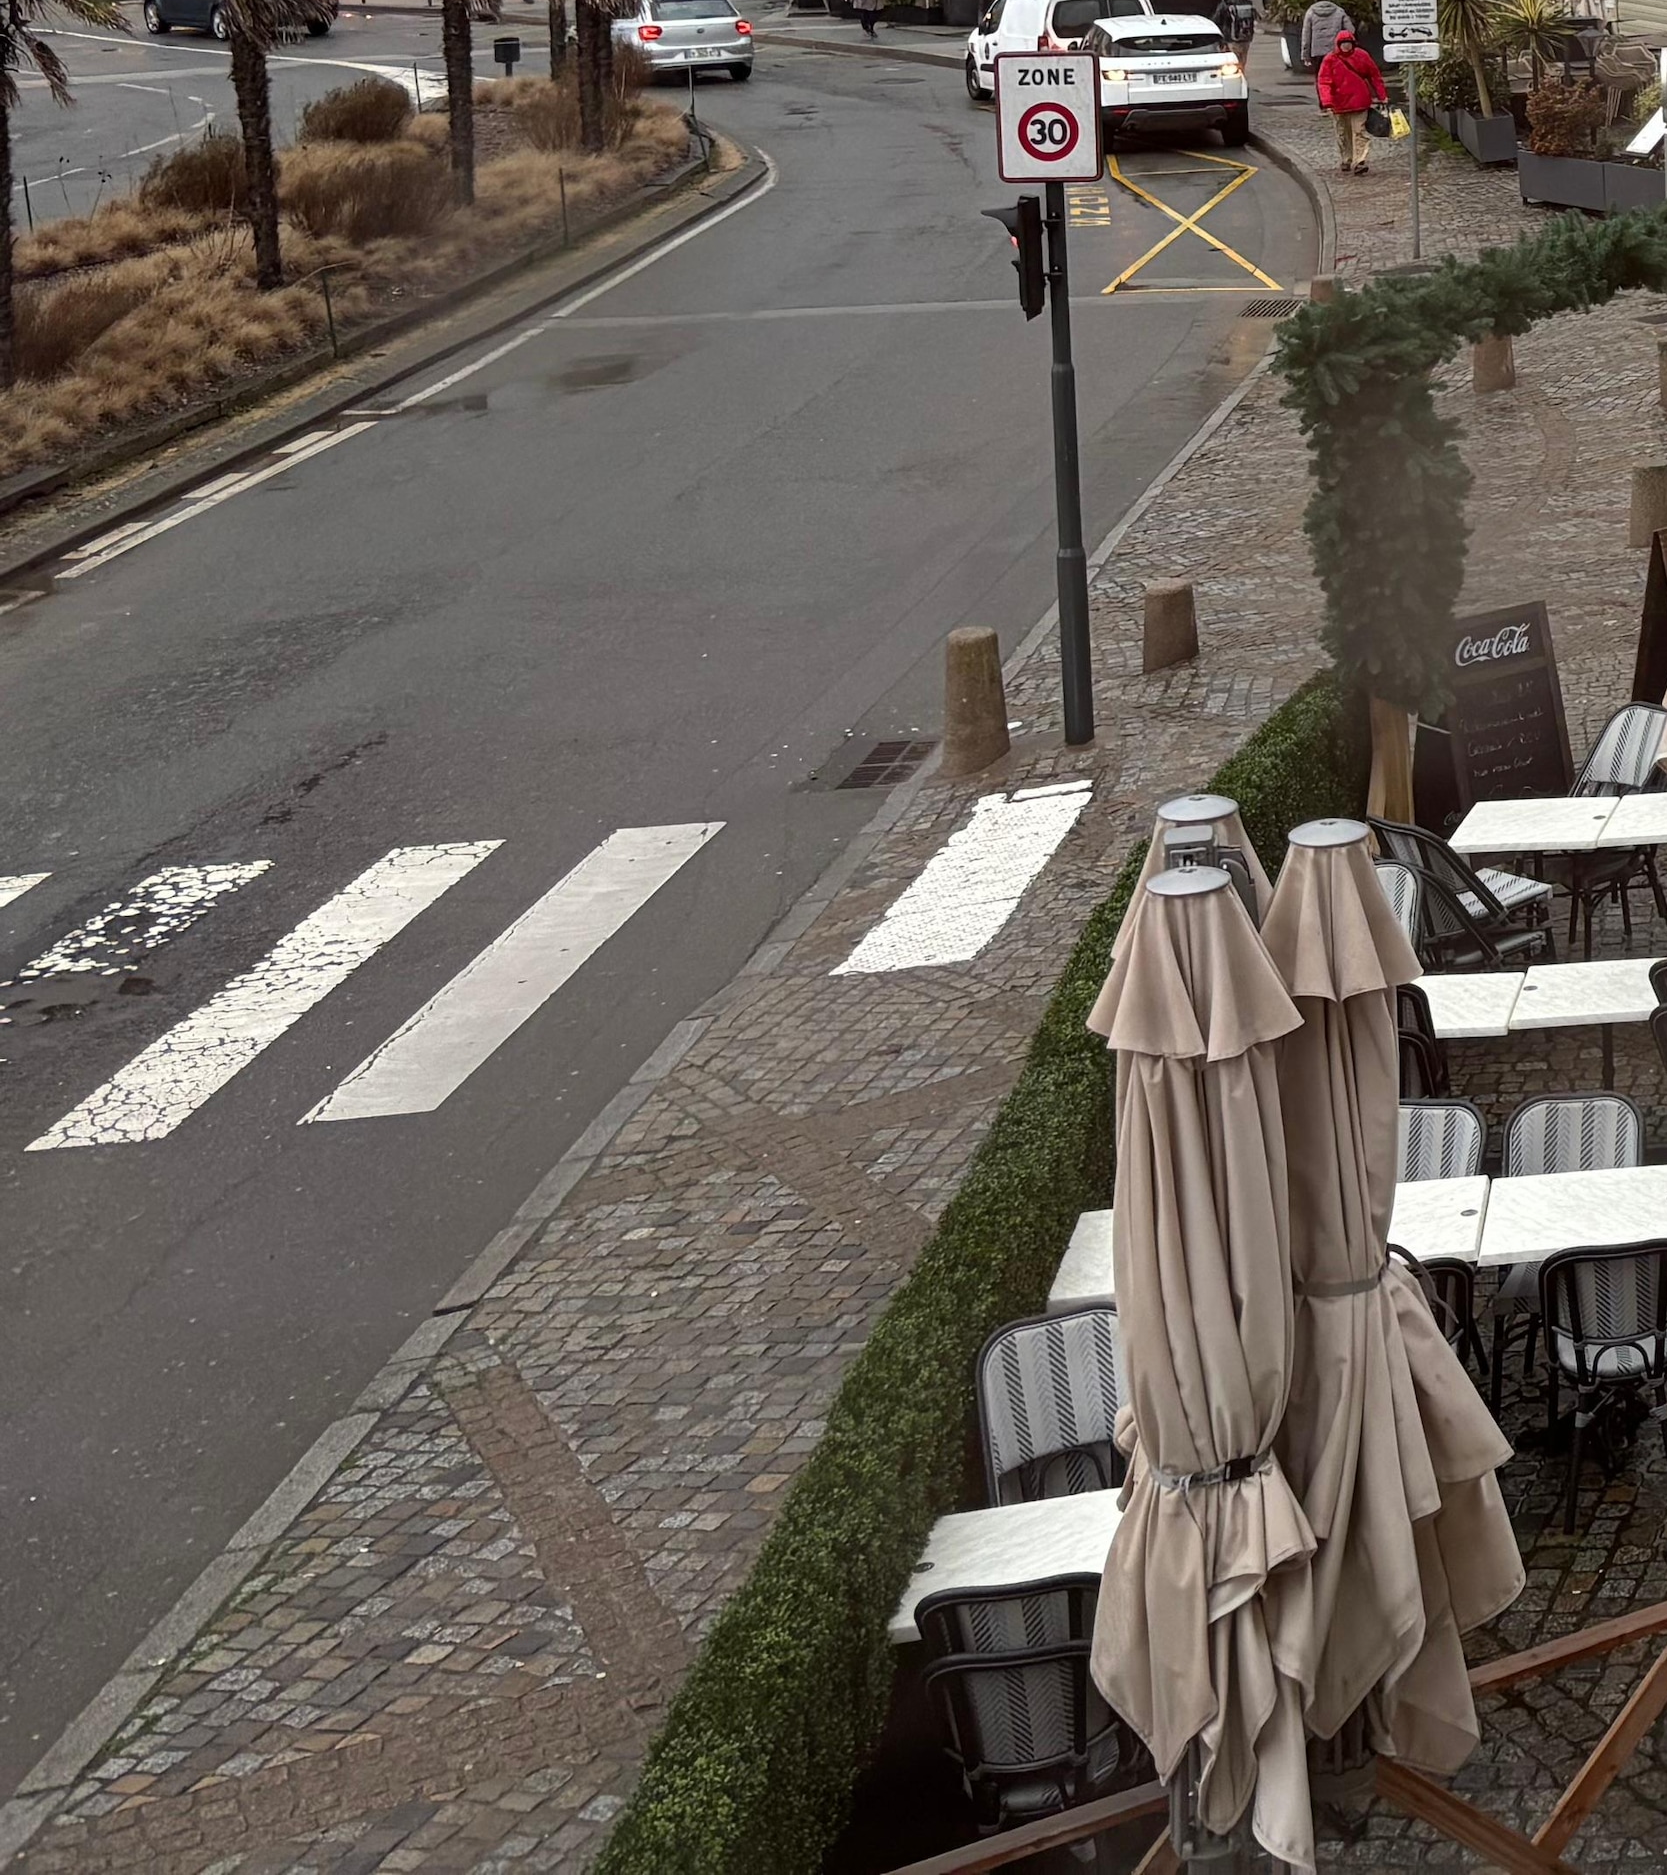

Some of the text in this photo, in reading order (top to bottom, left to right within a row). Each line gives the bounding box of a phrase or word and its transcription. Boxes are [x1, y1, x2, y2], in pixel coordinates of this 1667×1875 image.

[1018, 68, 1076, 86] ZONE
[1030, 118, 1068, 145] 30
[1455, 622, 1531, 667] Coca-Cola
